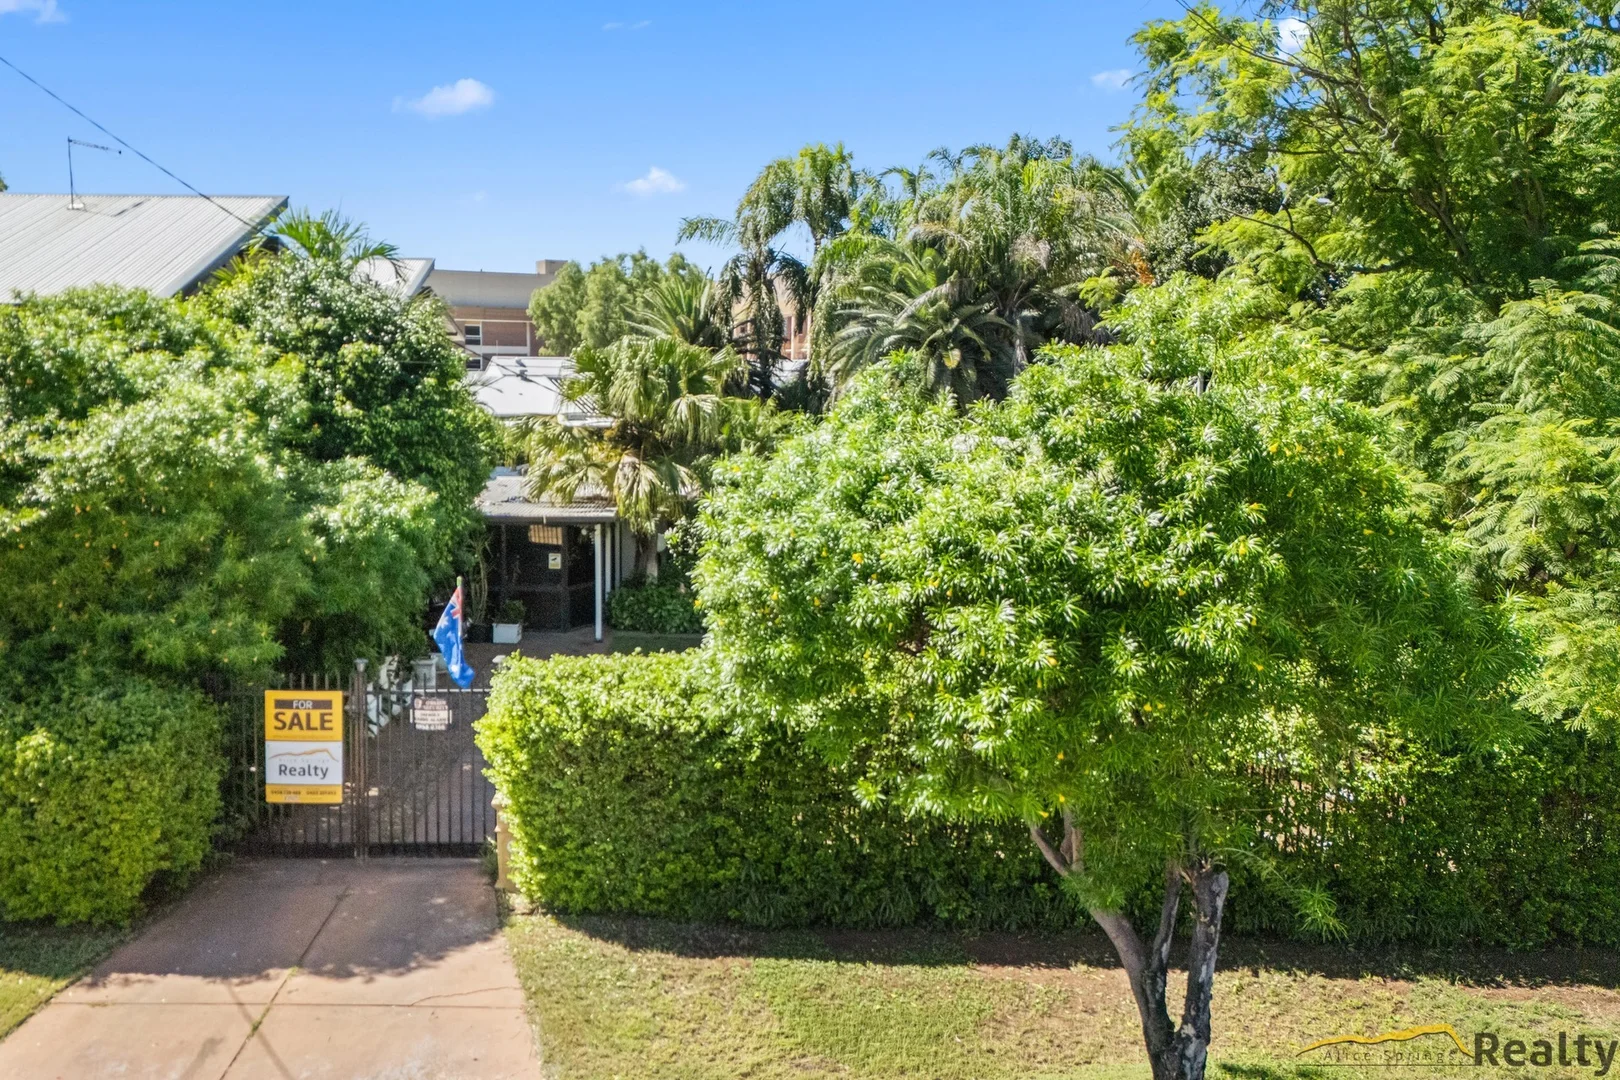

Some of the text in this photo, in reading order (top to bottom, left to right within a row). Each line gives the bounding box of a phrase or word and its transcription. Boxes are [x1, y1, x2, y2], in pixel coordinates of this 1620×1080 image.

[292, 699, 313, 710] FOR
[273, 711, 334, 732] SALE
[278, 763, 329, 780] Realty
